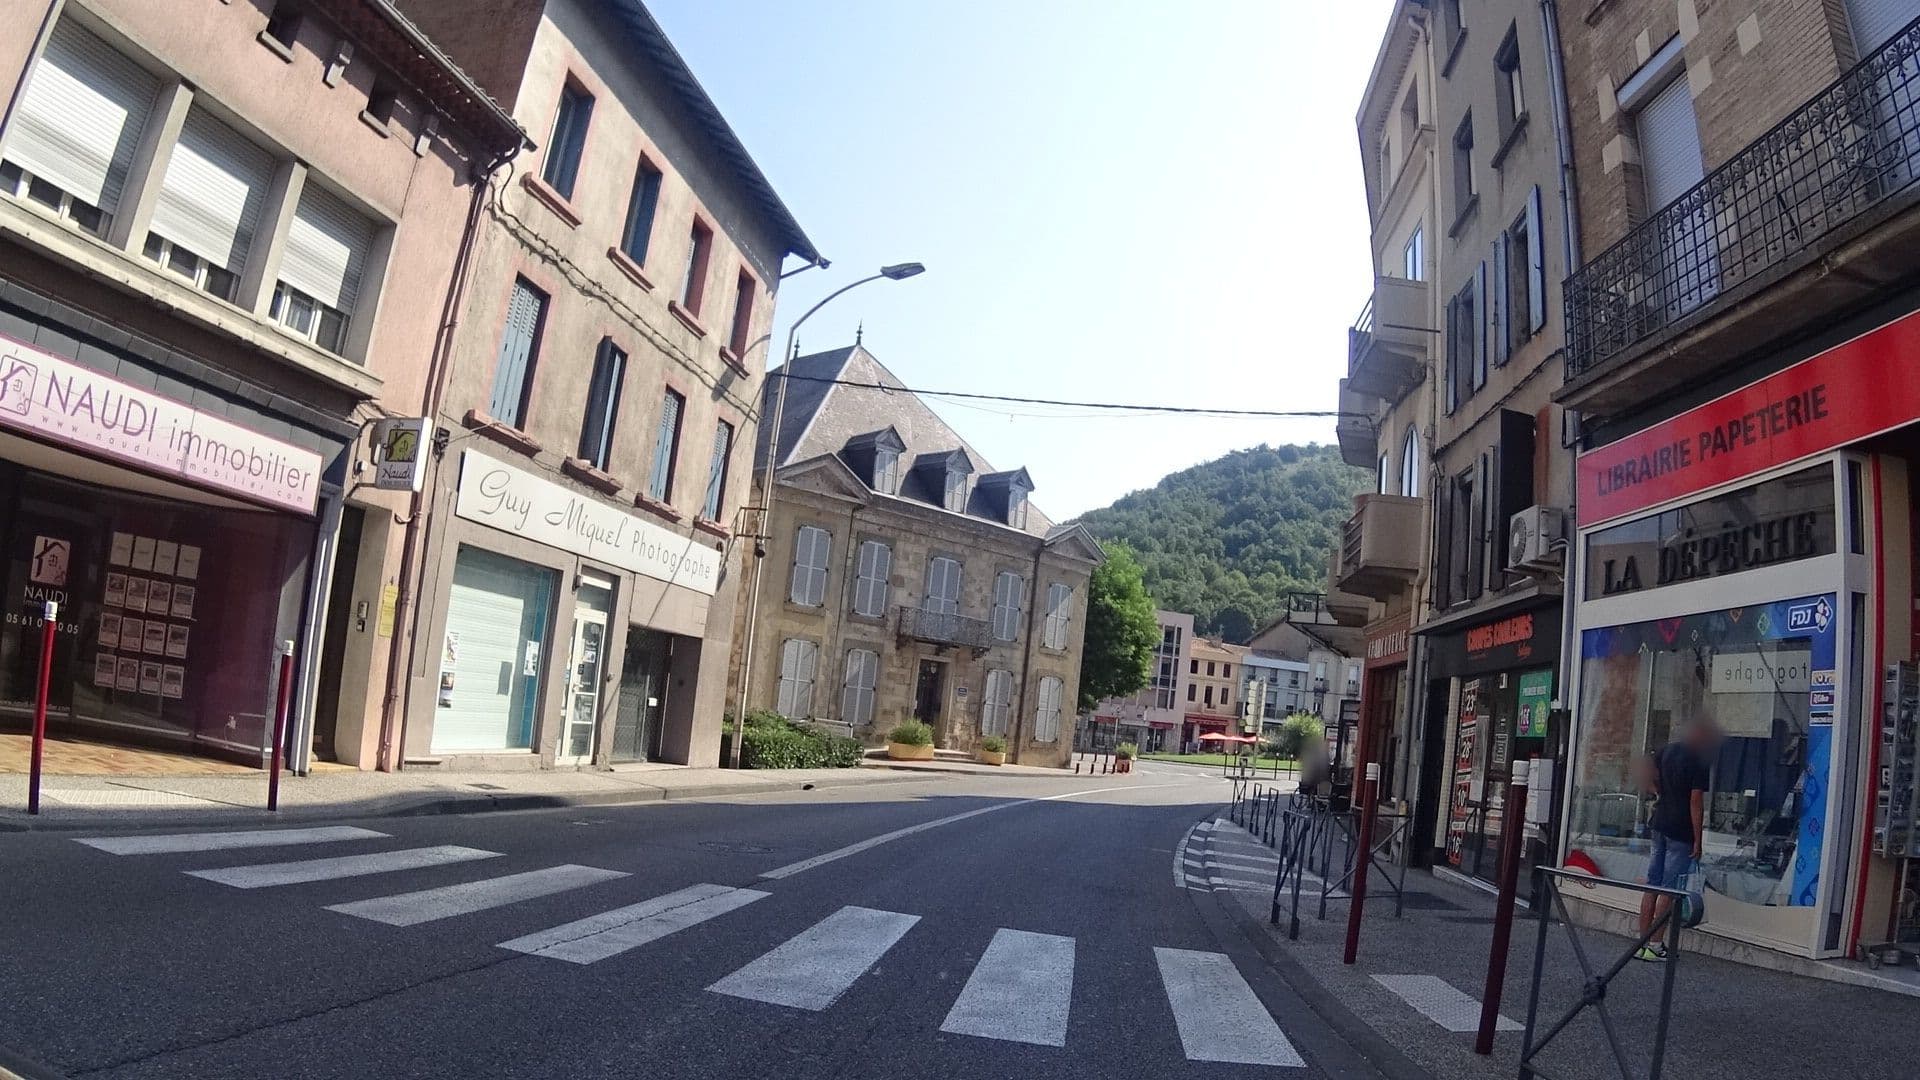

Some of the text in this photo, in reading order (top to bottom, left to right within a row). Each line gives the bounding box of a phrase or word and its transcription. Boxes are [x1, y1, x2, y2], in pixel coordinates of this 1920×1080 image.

[44, 370, 312, 492] NAUDI immobilier
[1598, 384, 1829, 497] LIBRAIRIE PAPETERIE
[479, 469, 711, 580] Guy Miquel Photographe
[1602, 510, 1818, 595] LA DÉPÊCHE
[6, 613, 18, 624] 05
[67, 623, 79, 634] 05
[24, 585, 68, 605] NAUDI
[1790, 608, 1812, 627] FDJ
